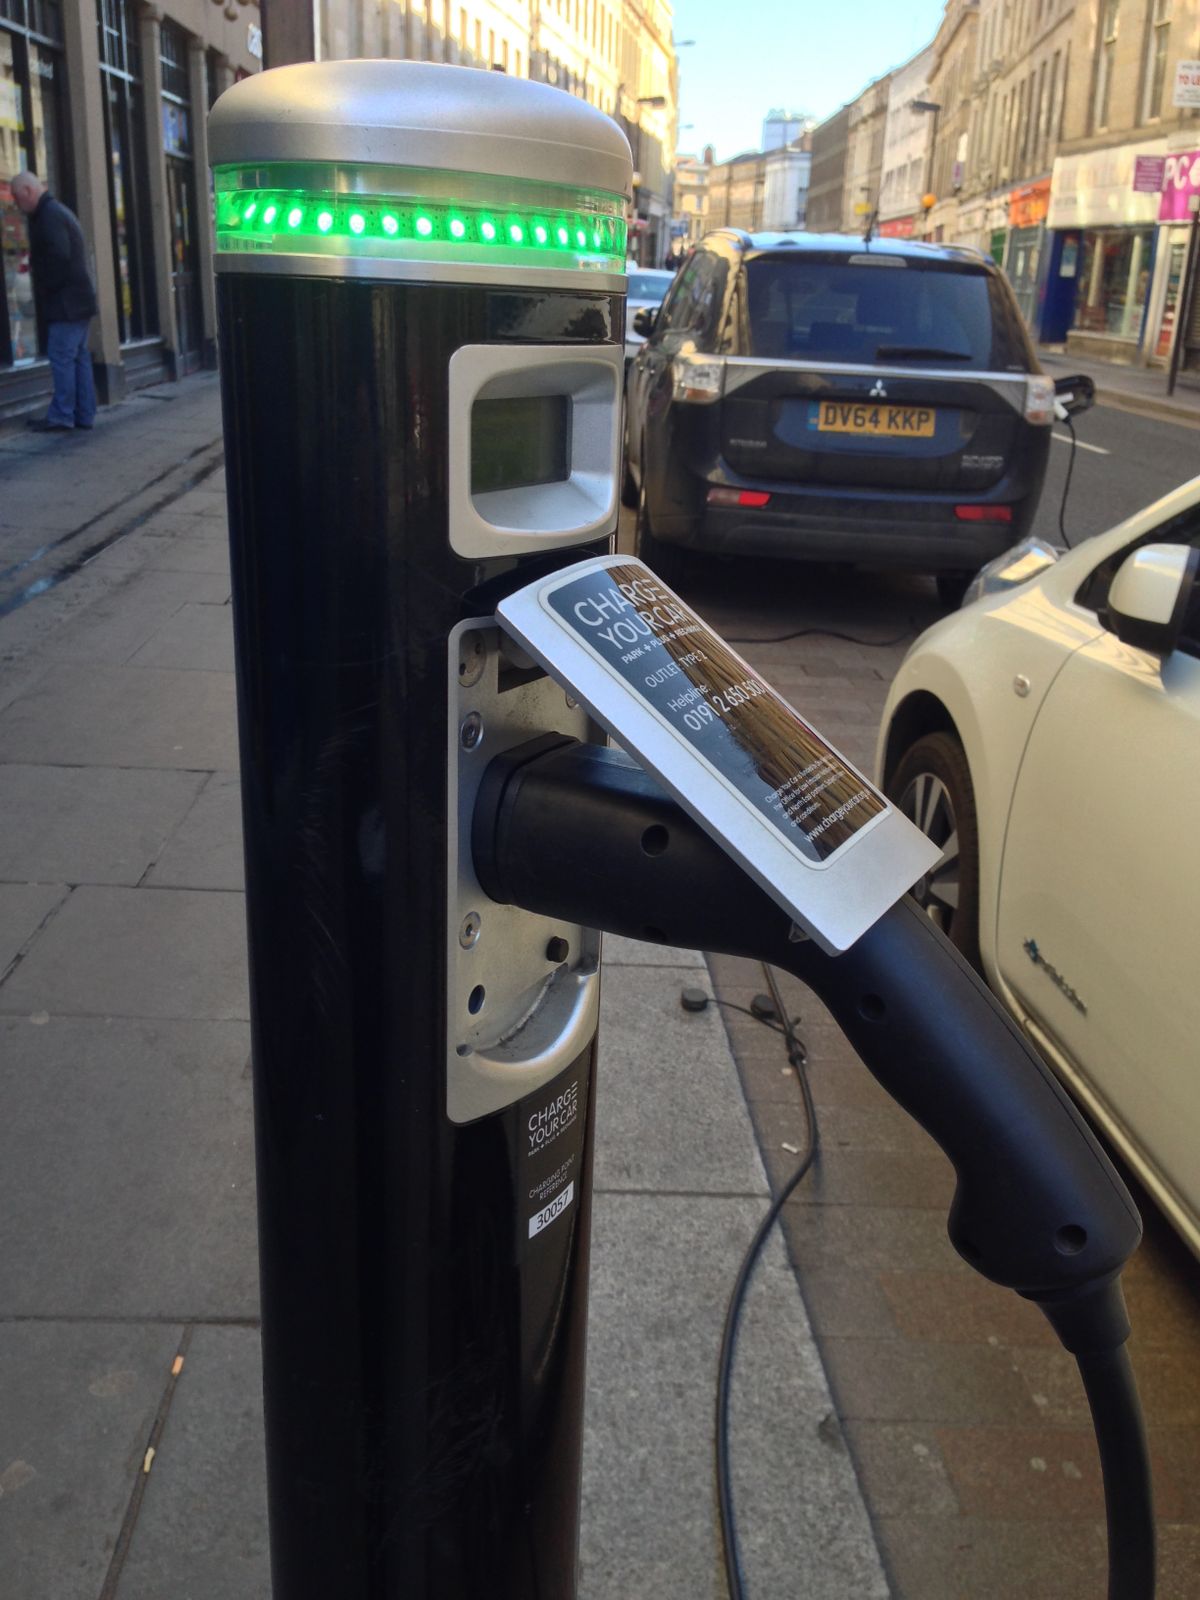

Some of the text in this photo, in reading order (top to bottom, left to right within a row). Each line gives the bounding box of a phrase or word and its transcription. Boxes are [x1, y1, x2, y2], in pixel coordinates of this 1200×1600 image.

[823, 404, 931, 432] DV64 KKP
[573, 578, 669, 627] CHARGE
[597, 602, 692, 650] YOUR CAR
[621, 647, 646, 664] PARK
[649, 633, 671, 648] PLUG
[678, 651, 701, 668] TYPE
[699, 649, 708, 662] 2
[683, 679, 767, 731] 0191 2 650 500
[789, 798, 805, 812] North
[528, 1080, 578, 1131] CHARGE
[528, 1116, 559, 1147] YOUR
[560, 1099, 578, 1125] CAR
[536, 1190, 569, 1230] 30057
